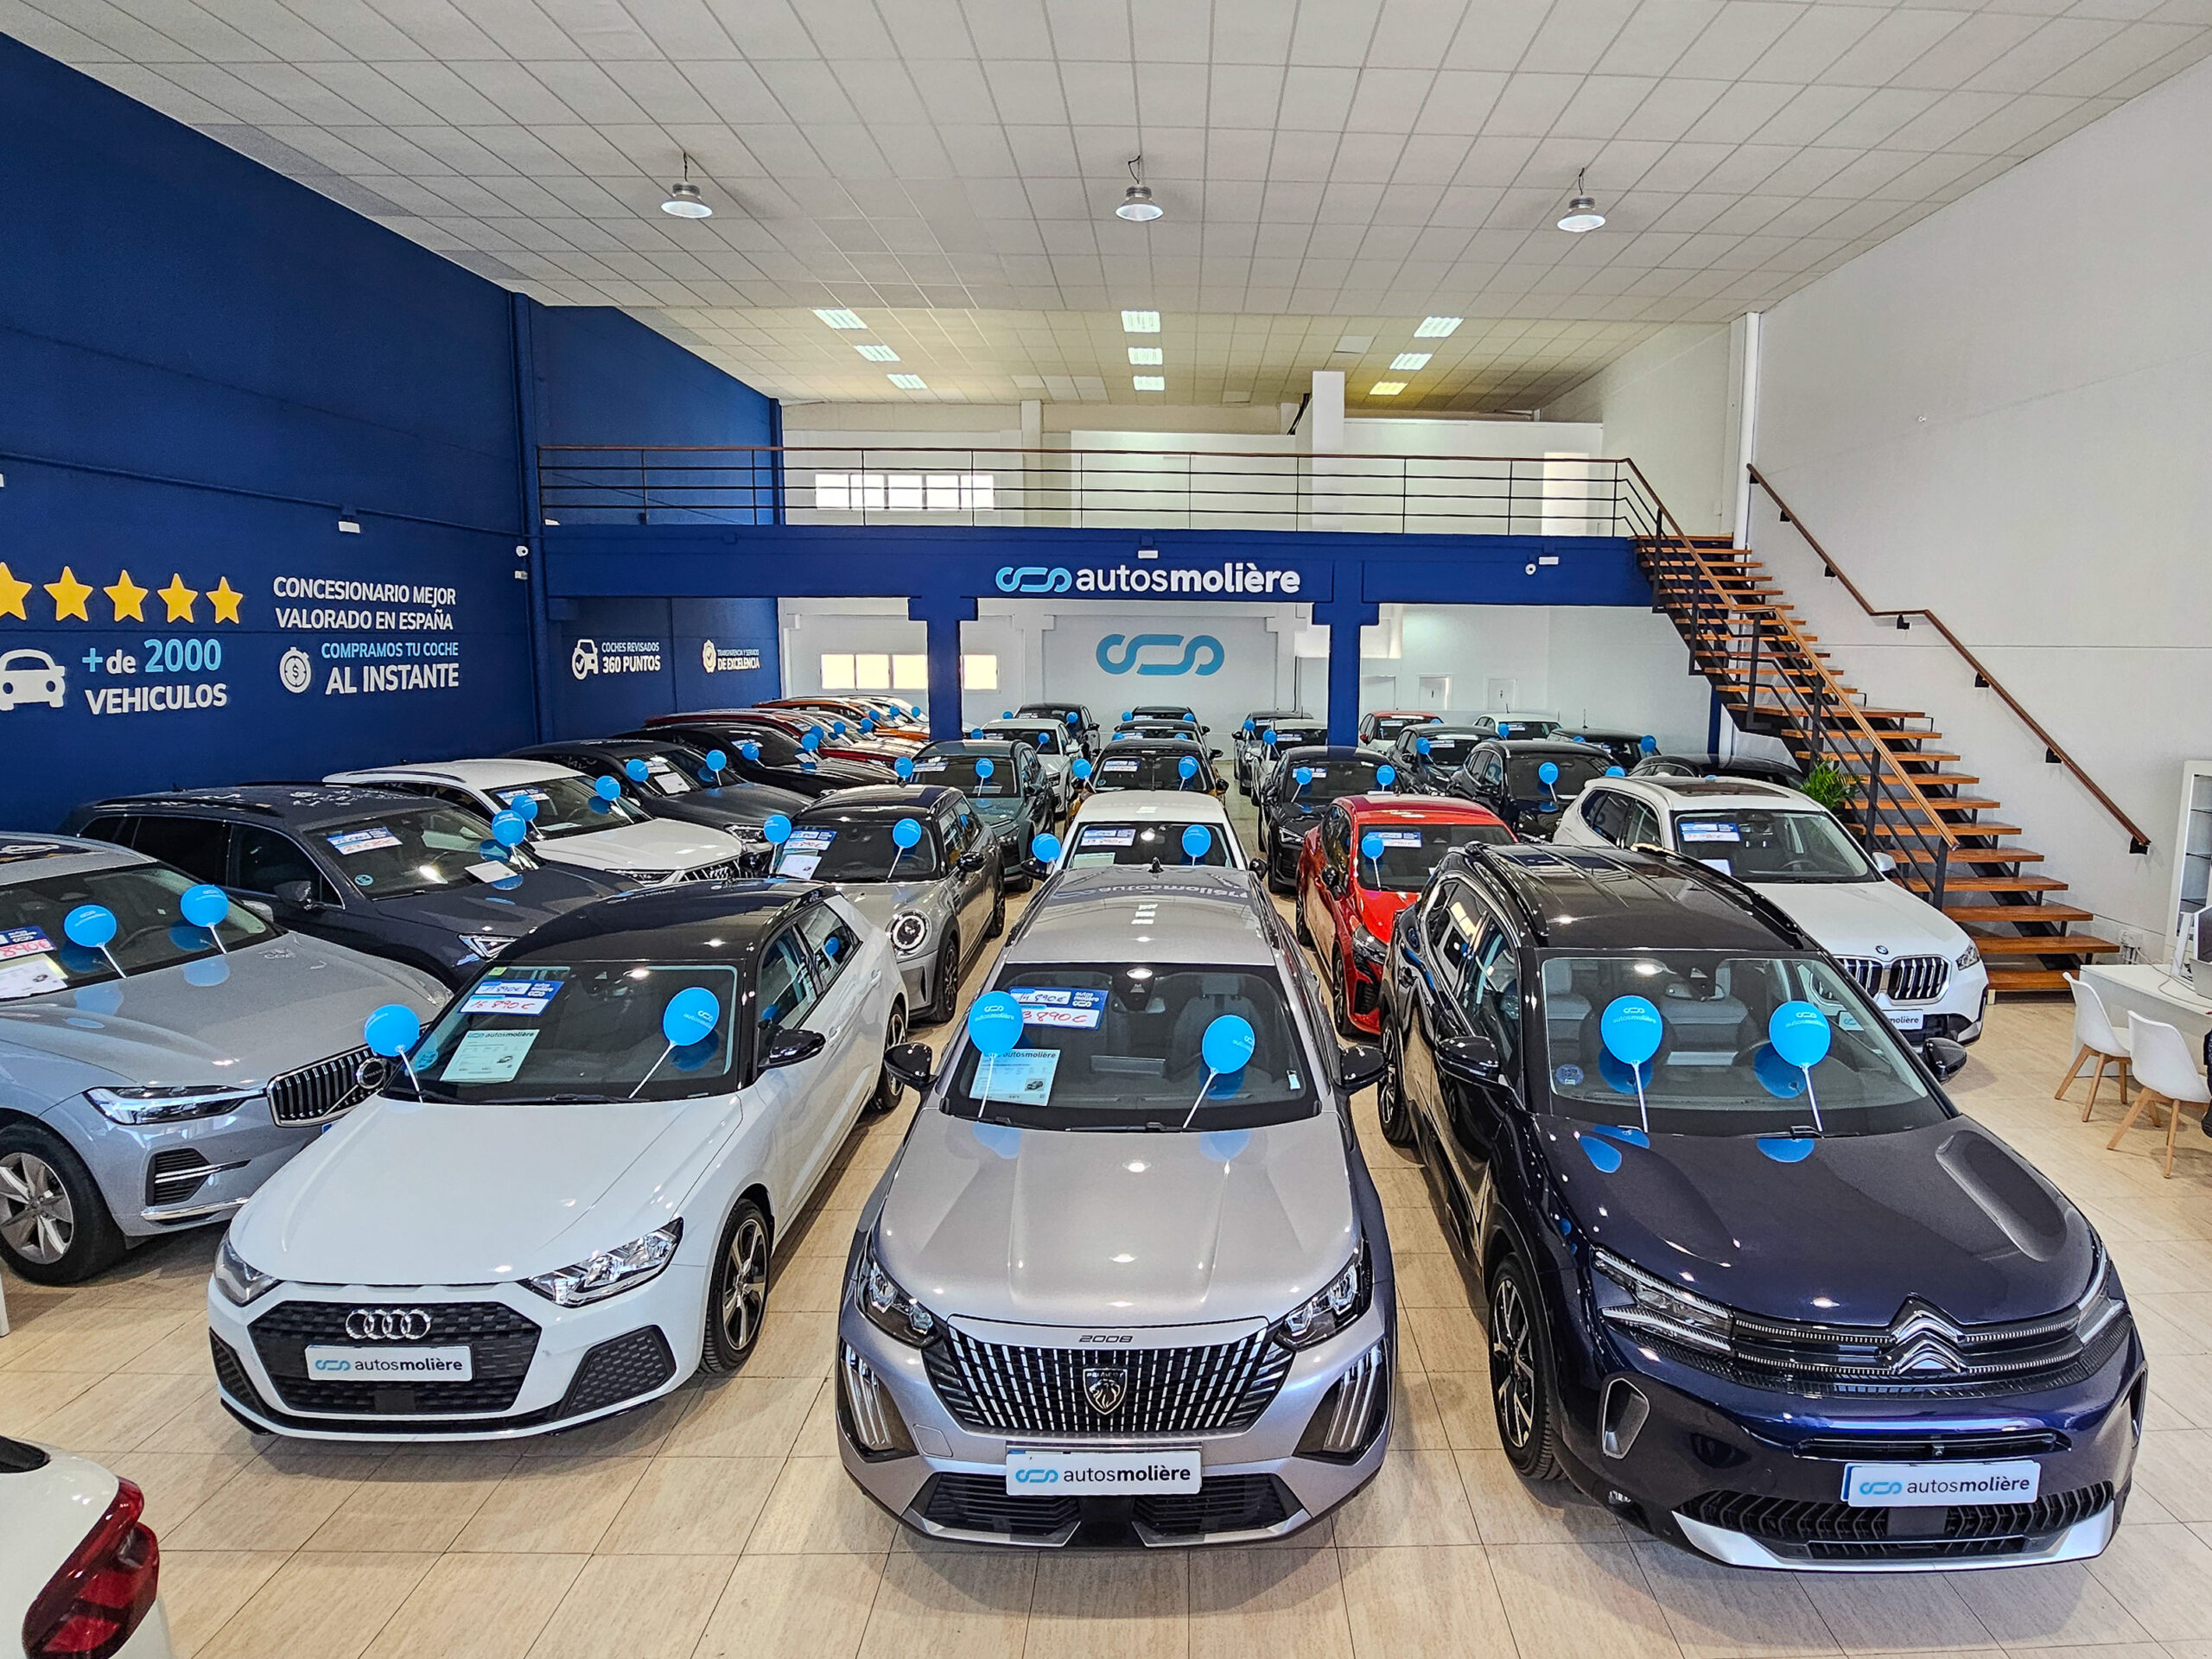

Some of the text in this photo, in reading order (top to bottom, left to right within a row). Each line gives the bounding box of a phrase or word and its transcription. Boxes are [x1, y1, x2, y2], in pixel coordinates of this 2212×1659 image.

[1076, 563, 1300, 594] autosmolière
[273, 576, 456, 607] CONCESIONARIO MEJOR
[276, 607, 454, 630] VALORADO EN ESPAÑA
[321, 642, 459, 658] COMPRAMOS TU COCHE
[601, 641, 660, 652] COCHES REVISADOS
[143, 639, 222, 673] 2000
[602, 654, 661, 674] 360 PUNTOS
[717, 657, 760, 671] DE EXCELENCIA
[326, 663, 460, 695] AL INSTANTE
[85, 683, 228, 715] VEHICULOS
[1002, 1051, 1057, 1059] autosmolière
[1079, 1334, 1134, 1344] 2008
[355, 1357, 463, 1371] autosmolière
[1063, 1465, 1192, 1483] autosmolière
[1906, 1476, 2031, 1494] autosmolière
